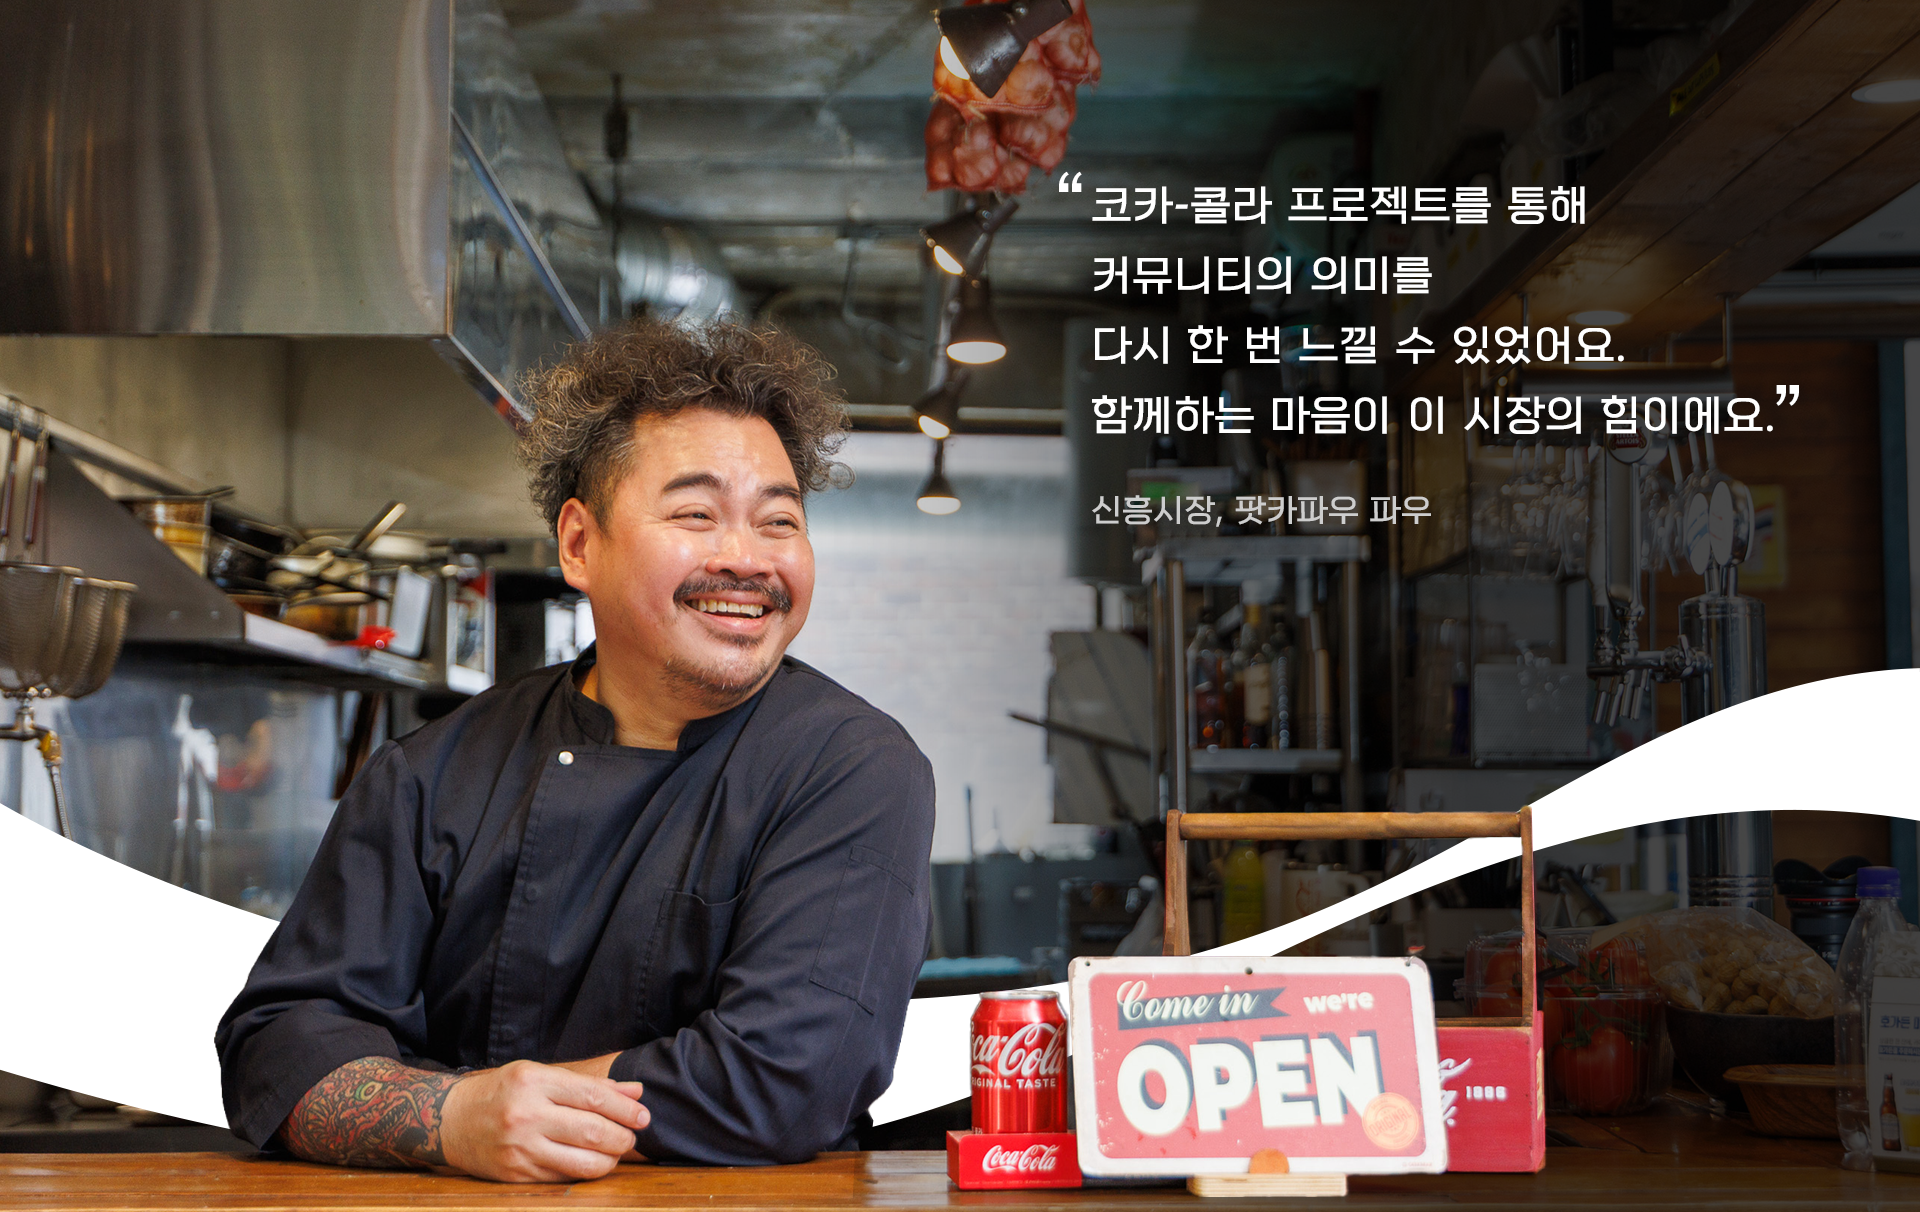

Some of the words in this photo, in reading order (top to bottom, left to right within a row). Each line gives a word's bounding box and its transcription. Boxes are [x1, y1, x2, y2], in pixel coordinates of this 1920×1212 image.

[1117, 980, 1214, 1021] Come
[1218, 985, 1259, 1016] in
[1303, 991, 1375, 1015] we're
[1879, 1014, 1911, 1030] 호가든
[1016, 1077, 1057, 1089] TASTE
[1117, 1032, 1384, 1137] OPEN
[1368, 1106, 1412, 1136] ORIGINAL
[982, 1144, 1060, 1171] Coca-Cola
